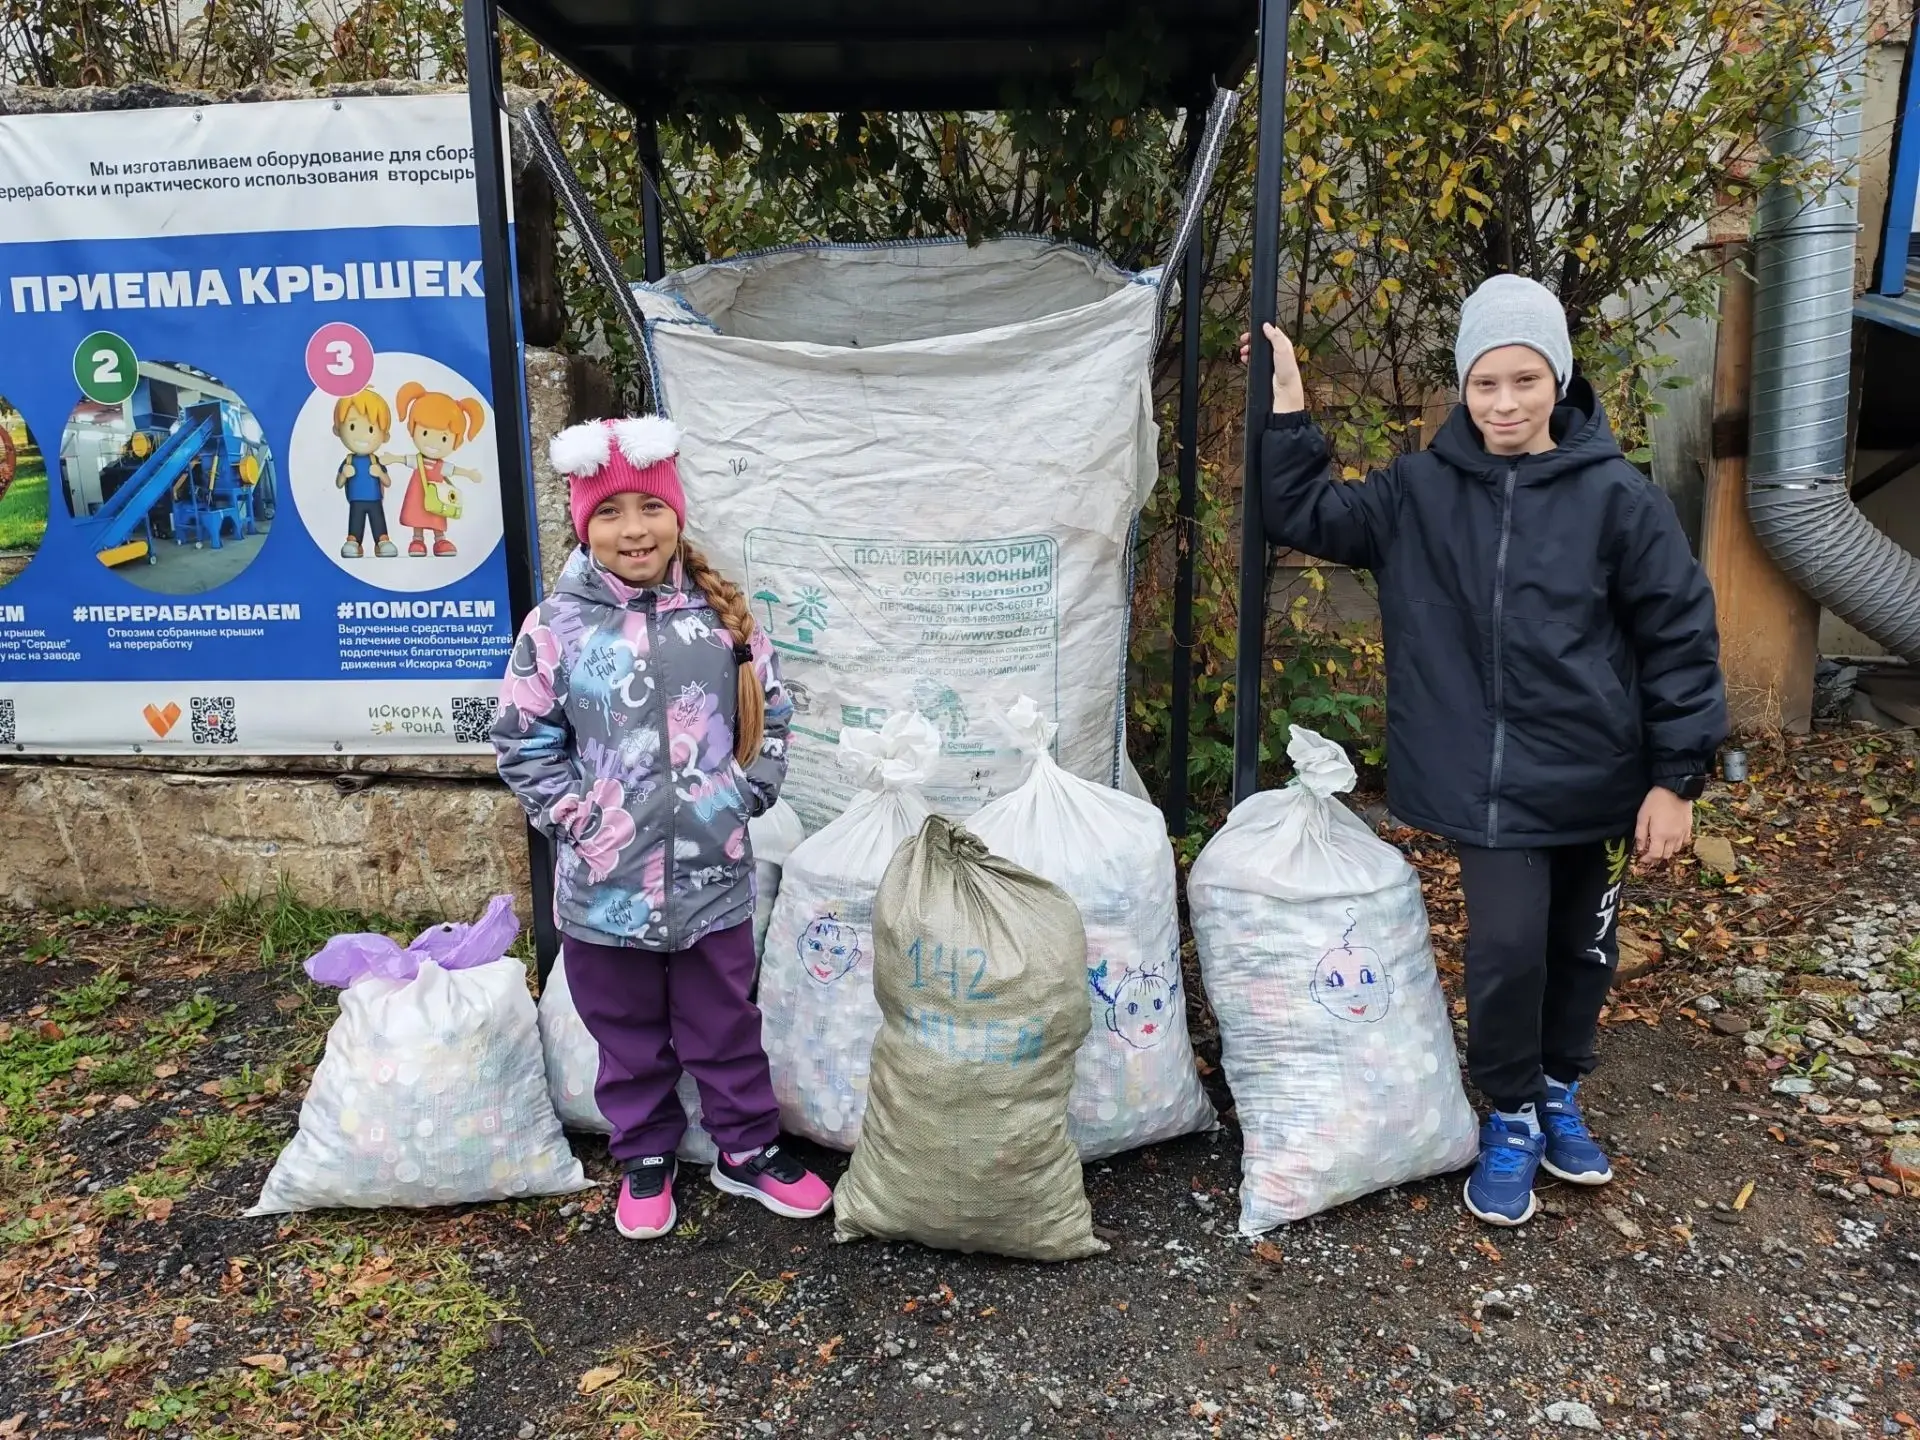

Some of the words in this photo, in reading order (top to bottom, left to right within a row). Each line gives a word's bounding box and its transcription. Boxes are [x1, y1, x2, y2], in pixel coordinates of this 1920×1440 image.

[90, 161, 118, 176] Мы
[122, 155, 252, 175] изготавливаем
[257, 149, 384, 170] оборудование
[388, 150, 421, 164] для
[0, 182, 97, 201] ереработки
[101, 184, 111, 195] и
[115, 174, 240, 198] практического
[245, 168, 378, 187] использования
[388, 169, 475, 185] вторсырь
[10, 270, 232, 312] ПРИЕМА
[239, 260, 485, 305] КРЫШЕК
[92, 349, 122, 383] 2
[325, 340, 355, 376] 3
[854, 544, 1051, 566] ПОЛИВИНИЛХЛОРИД
[937, 581, 1051, 598] Suspension)
[73, 603, 300, 622] #ПЕРЕРАБАТЫВАЕМ
[337, 600, 496, 619] #ПОМОГАЕМ
[4, 629, 46, 639] крышек
[107, 628, 154, 638] Отвозим
[157, 627, 217, 637] собранные
[219, 627, 264, 639] крышки
[338, 624, 409, 635] Вырученные
[412, 624, 464, 634] средства
[467, 623, 494, 634] идут
[109, 641, 122, 649] на
[124, 639, 193, 651] переработку
[339, 637, 353, 645] на
[356, 636, 400, 645] лечение
[403, 634, 479, 645] онкобольных
[482, 633, 513, 646] детей
[8, 652, 26, 660] нас
[29, 652, 41, 660] на
[43, 651, 81, 662] заводе
[340, 648, 408, 658] подопечных
[341, 660, 396, 671] движения
[399, 658, 453, 670] «Искорка
[455, 658, 493, 670] Фонд»
[595, 659, 617, 681] FUN
[402, 721, 445, 735] ФОНД
[906, 935, 996, 1002] 142
